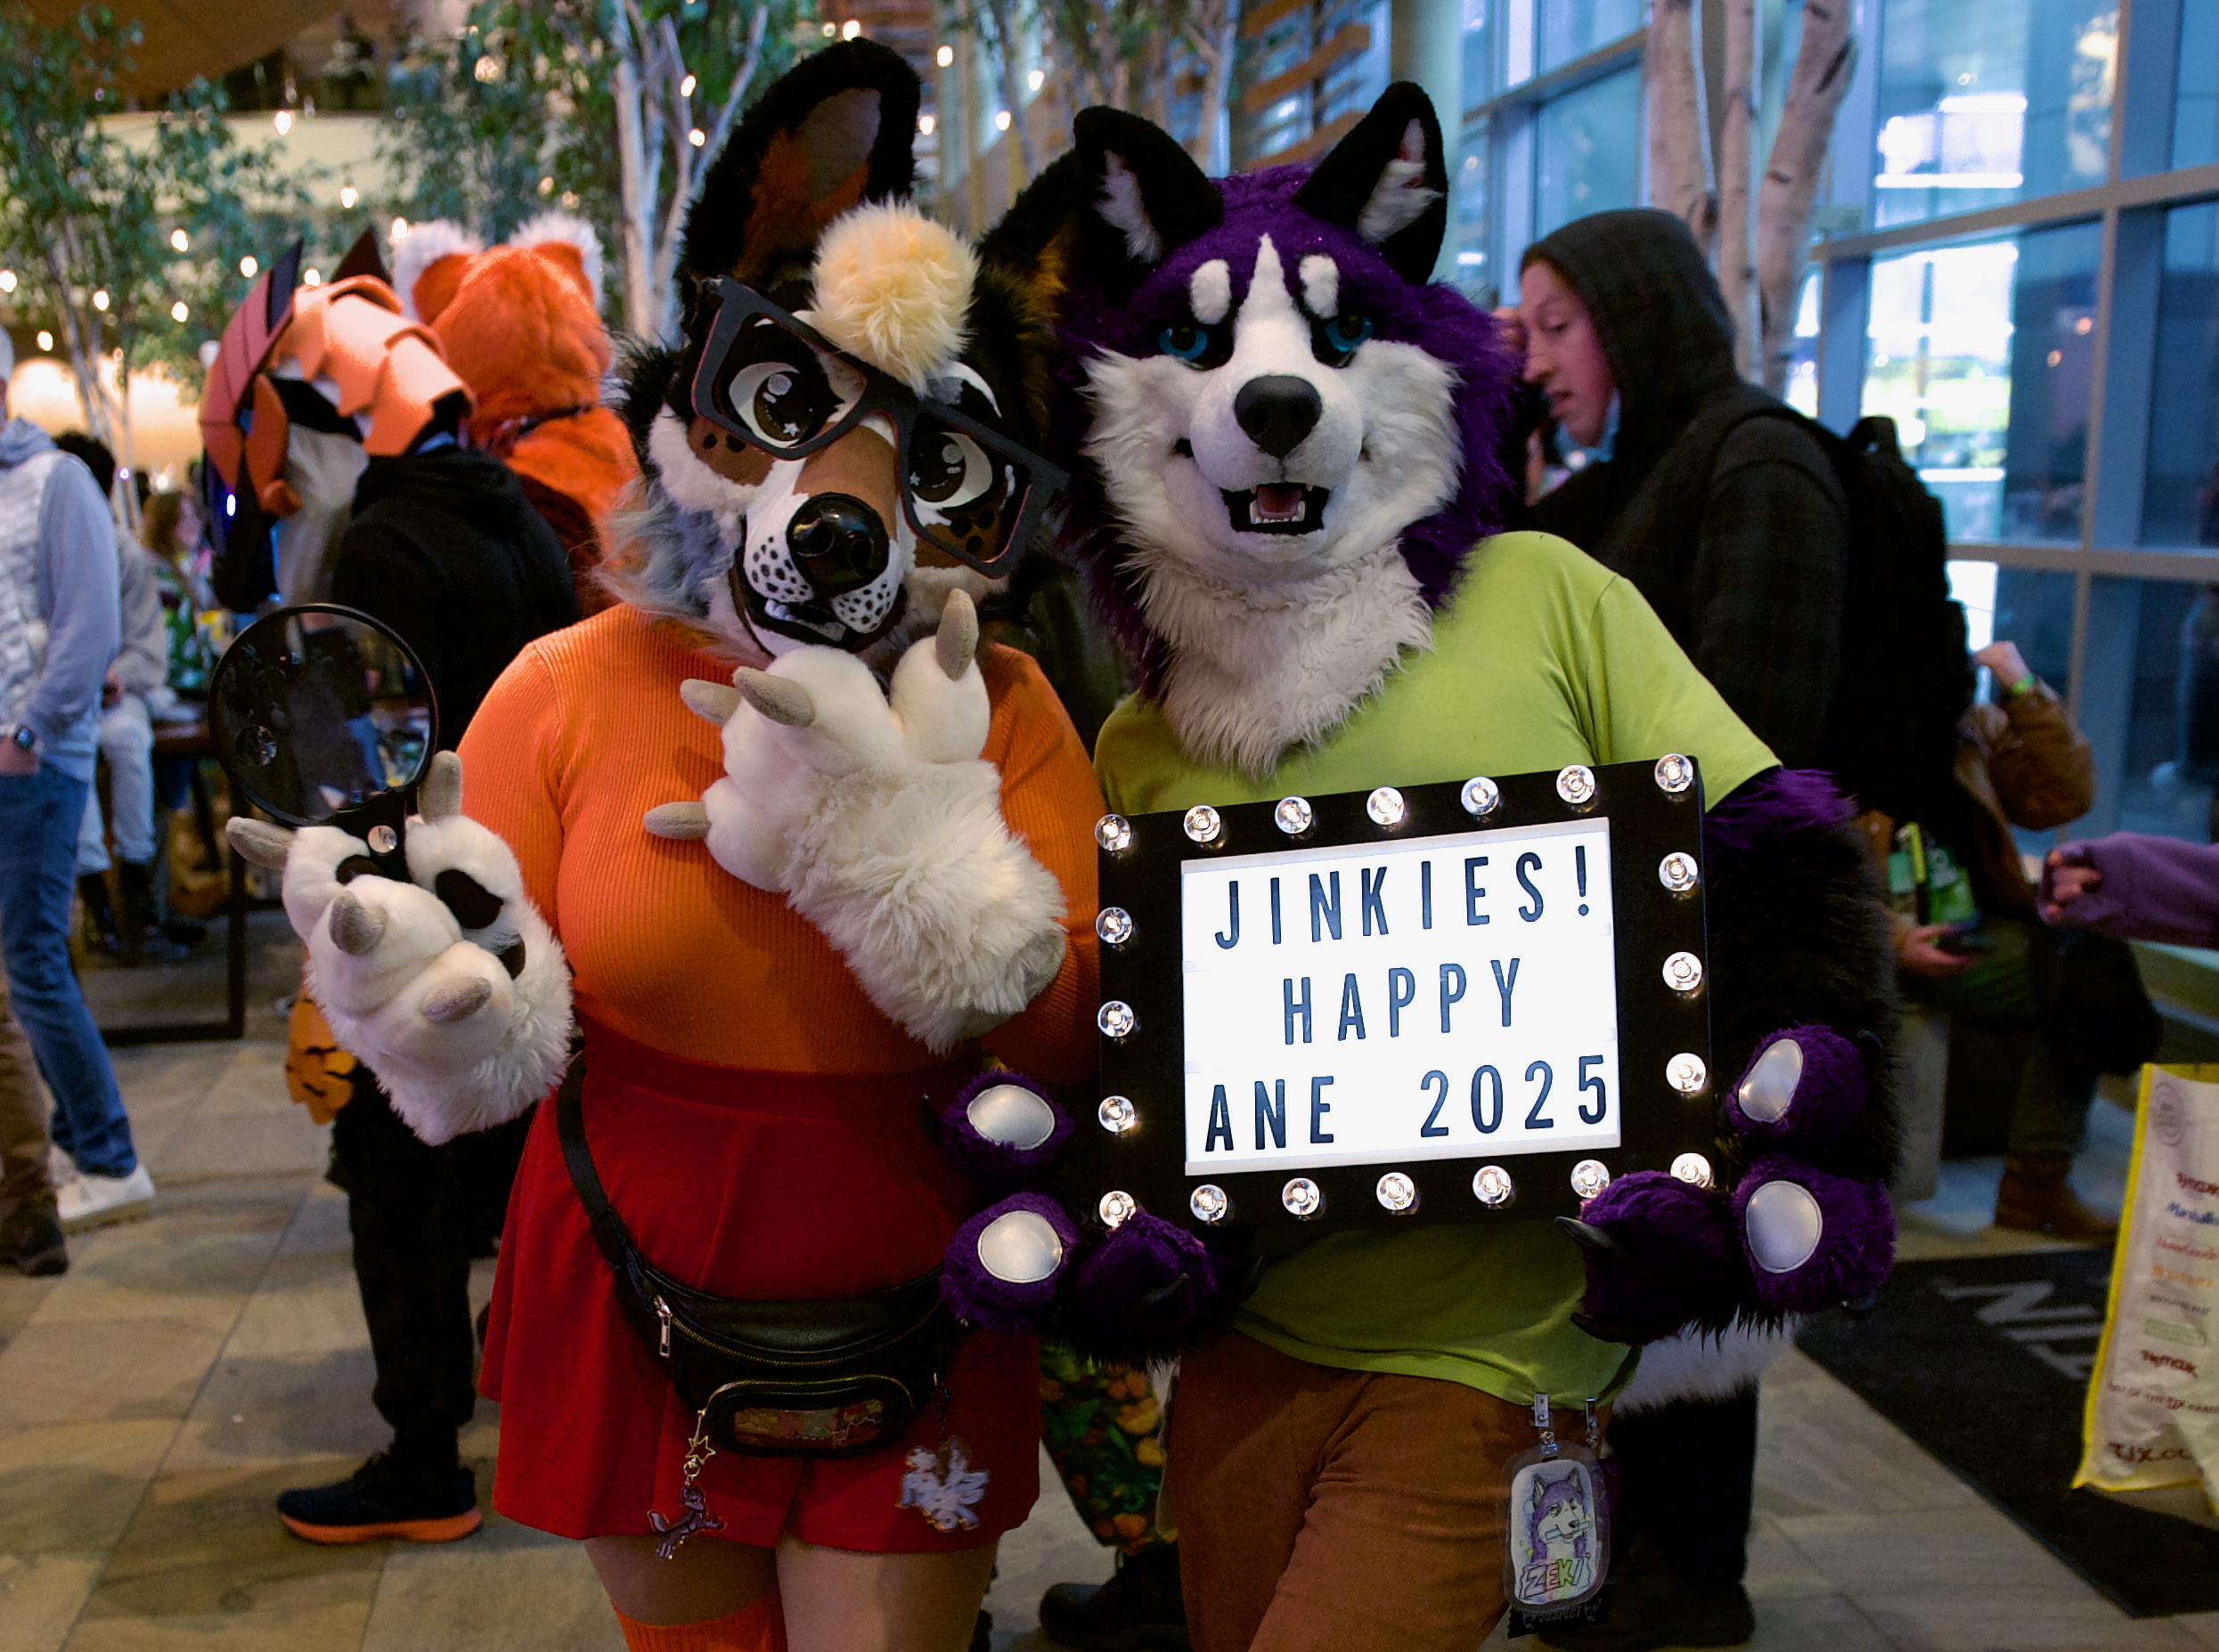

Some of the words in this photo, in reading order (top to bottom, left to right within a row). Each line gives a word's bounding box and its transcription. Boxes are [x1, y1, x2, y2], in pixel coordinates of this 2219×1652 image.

[1214, 845, 1591, 950] JINKIES!
[1283, 957, 1521, 1046] HAPPY
[1204, 1076, 1335, 1152] ANE
[1420, 1054, 1606, 1138] 2025
